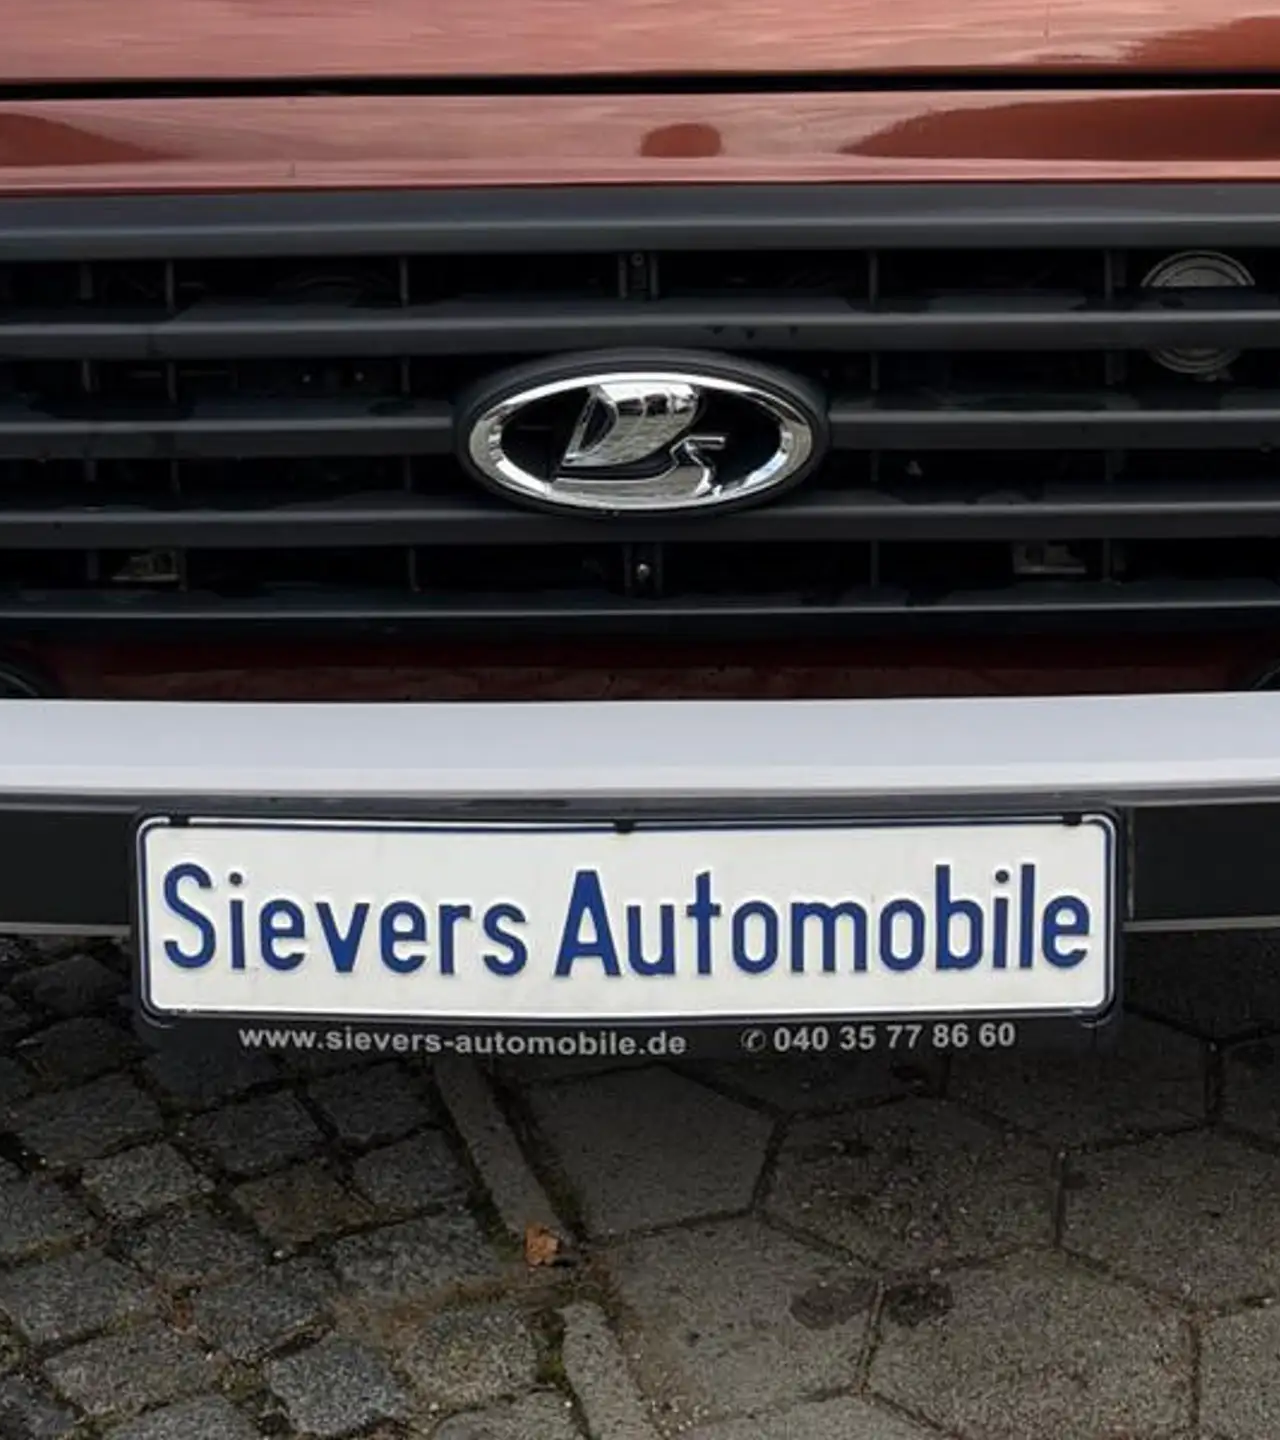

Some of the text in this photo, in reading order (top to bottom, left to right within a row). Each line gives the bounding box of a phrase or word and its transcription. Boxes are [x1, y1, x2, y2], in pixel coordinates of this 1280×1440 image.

[162, 862, 1091, 977] Sievers Automobile
[239, 1022, 1016, 1057] www.sievers-automobile.de 040 35 77 86 60
